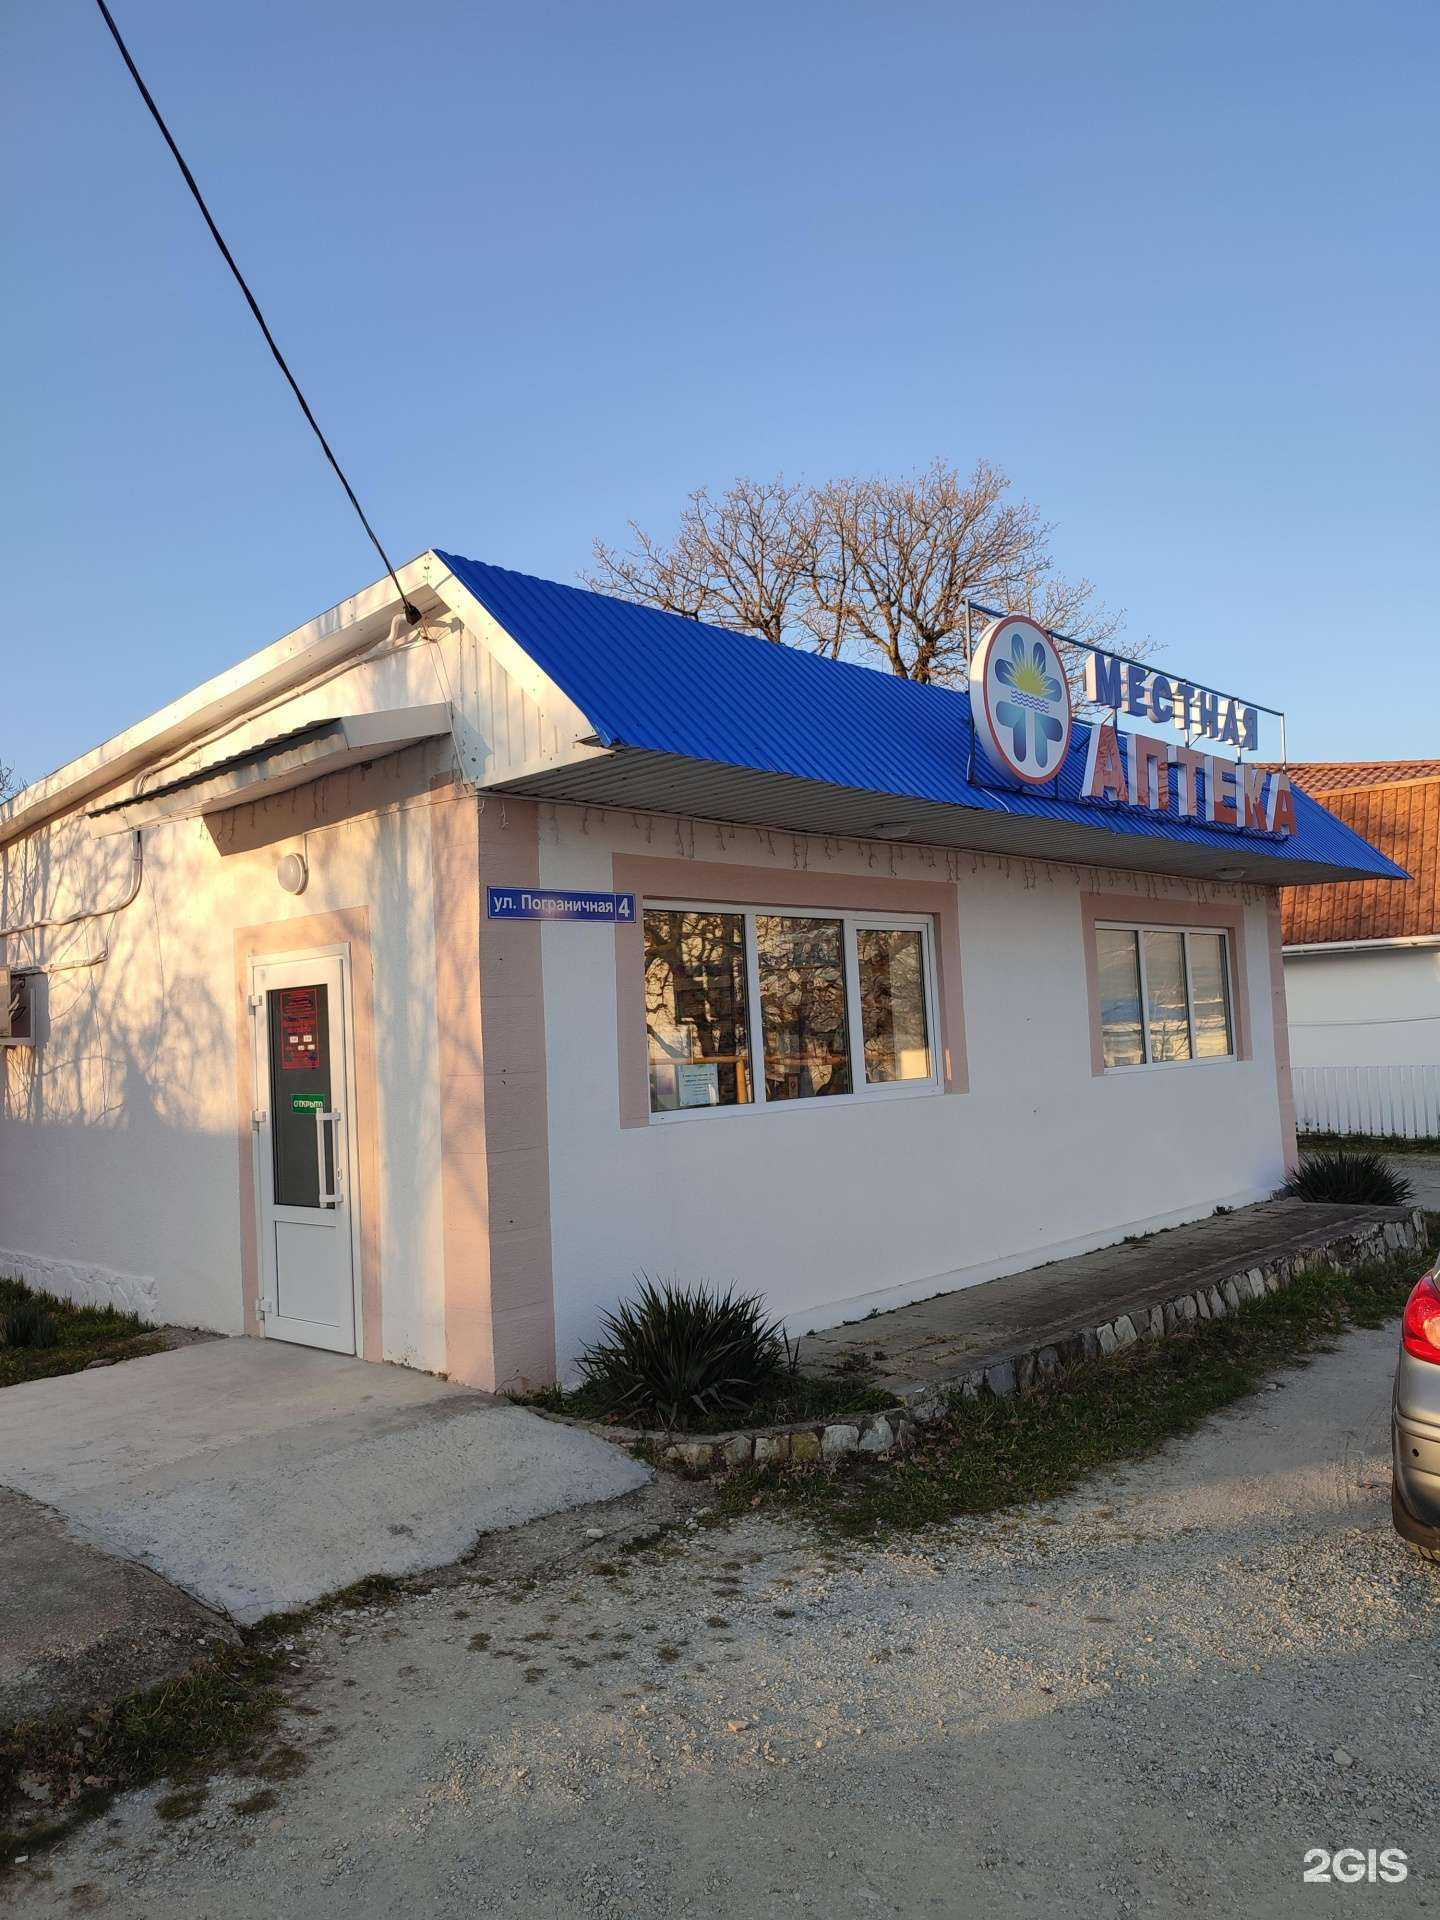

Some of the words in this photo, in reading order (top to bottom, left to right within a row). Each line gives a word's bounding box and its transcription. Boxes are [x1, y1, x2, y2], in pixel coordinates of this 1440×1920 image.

[1088, 652, 1258, 750] МЕСТНАЯ
[1082, 725, 1297, 836] АПТЕКА
[494, 896, 517, 912] ул.
[521, 895, 613, 914] Пограничная
[618, 897, 631, 918] 4
